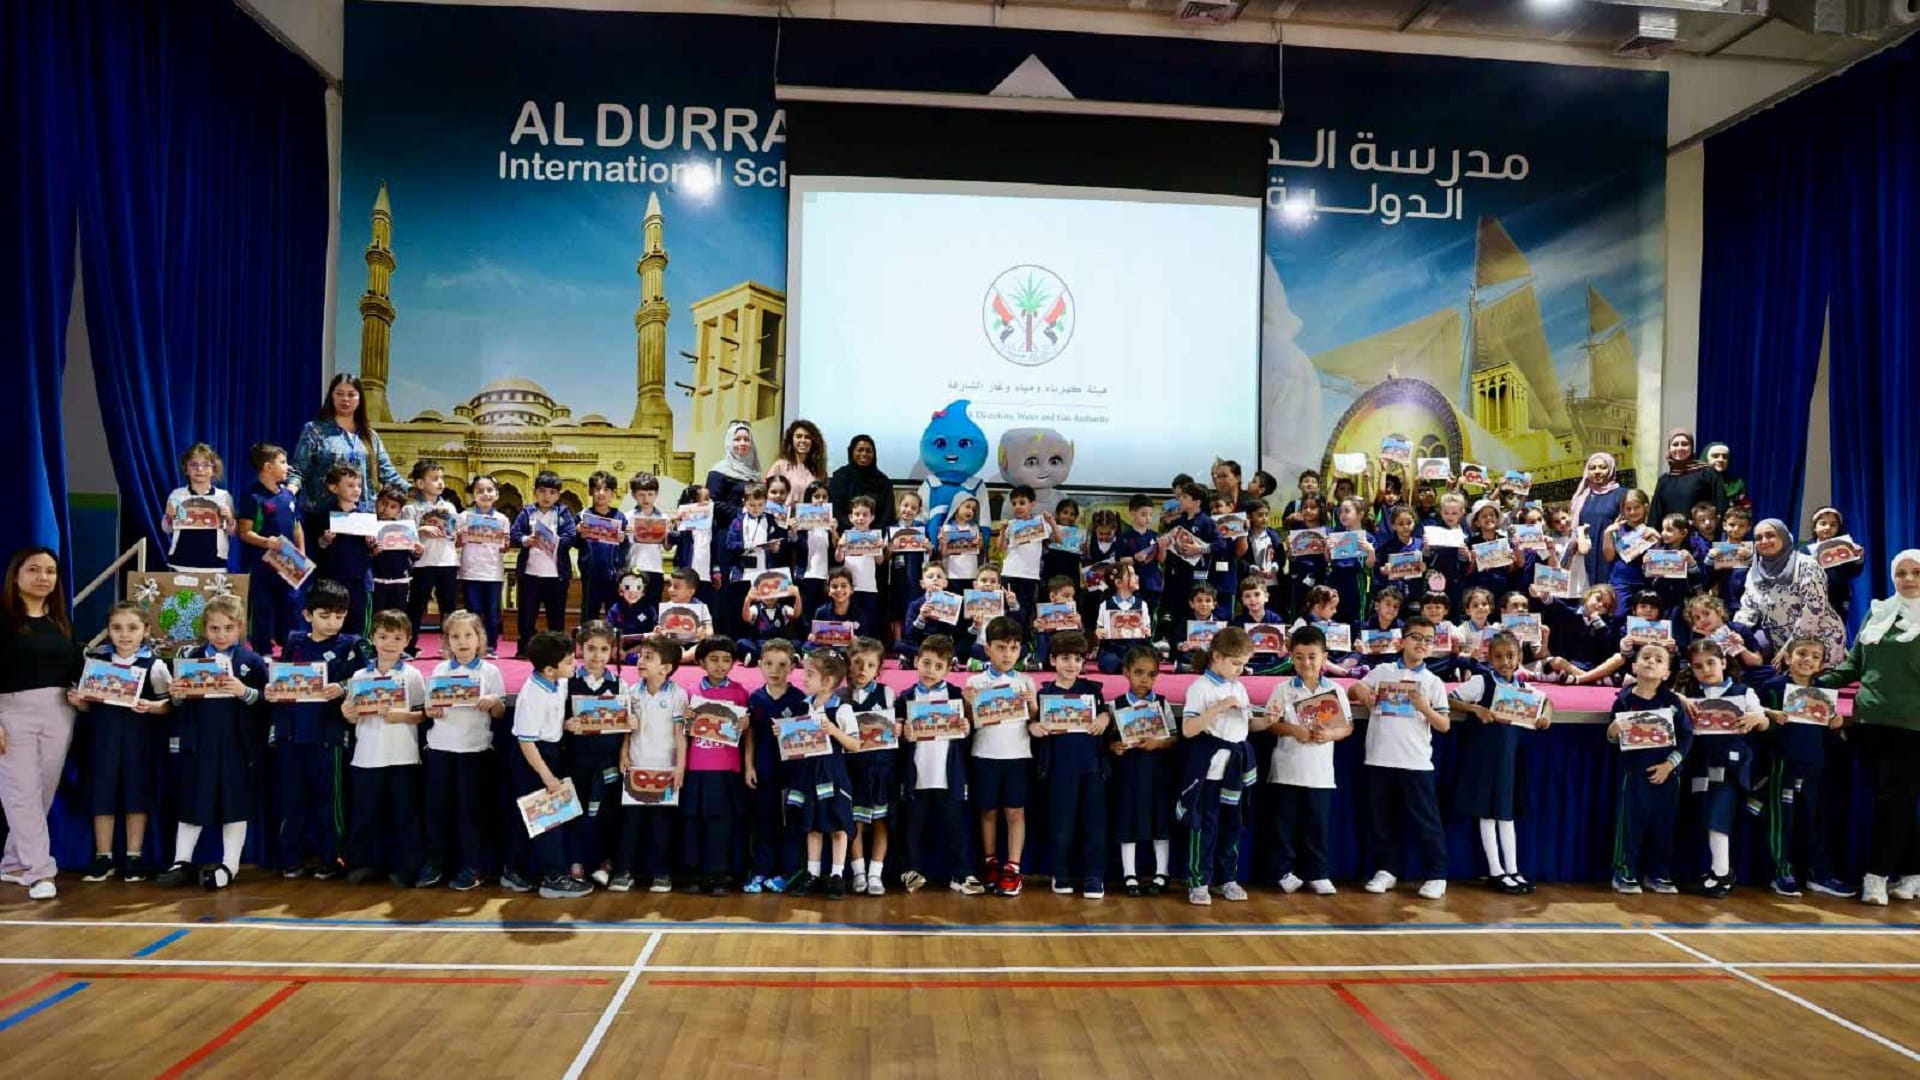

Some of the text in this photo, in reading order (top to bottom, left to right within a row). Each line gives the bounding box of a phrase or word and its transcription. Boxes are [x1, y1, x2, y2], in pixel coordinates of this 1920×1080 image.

[510, 100, 787, 153] AL DURRA
[1349, 131, 1530, 188] مدرسة
[1266, 176, 1463, 226] الدولية
[1040, 412, 1055, 422] and
